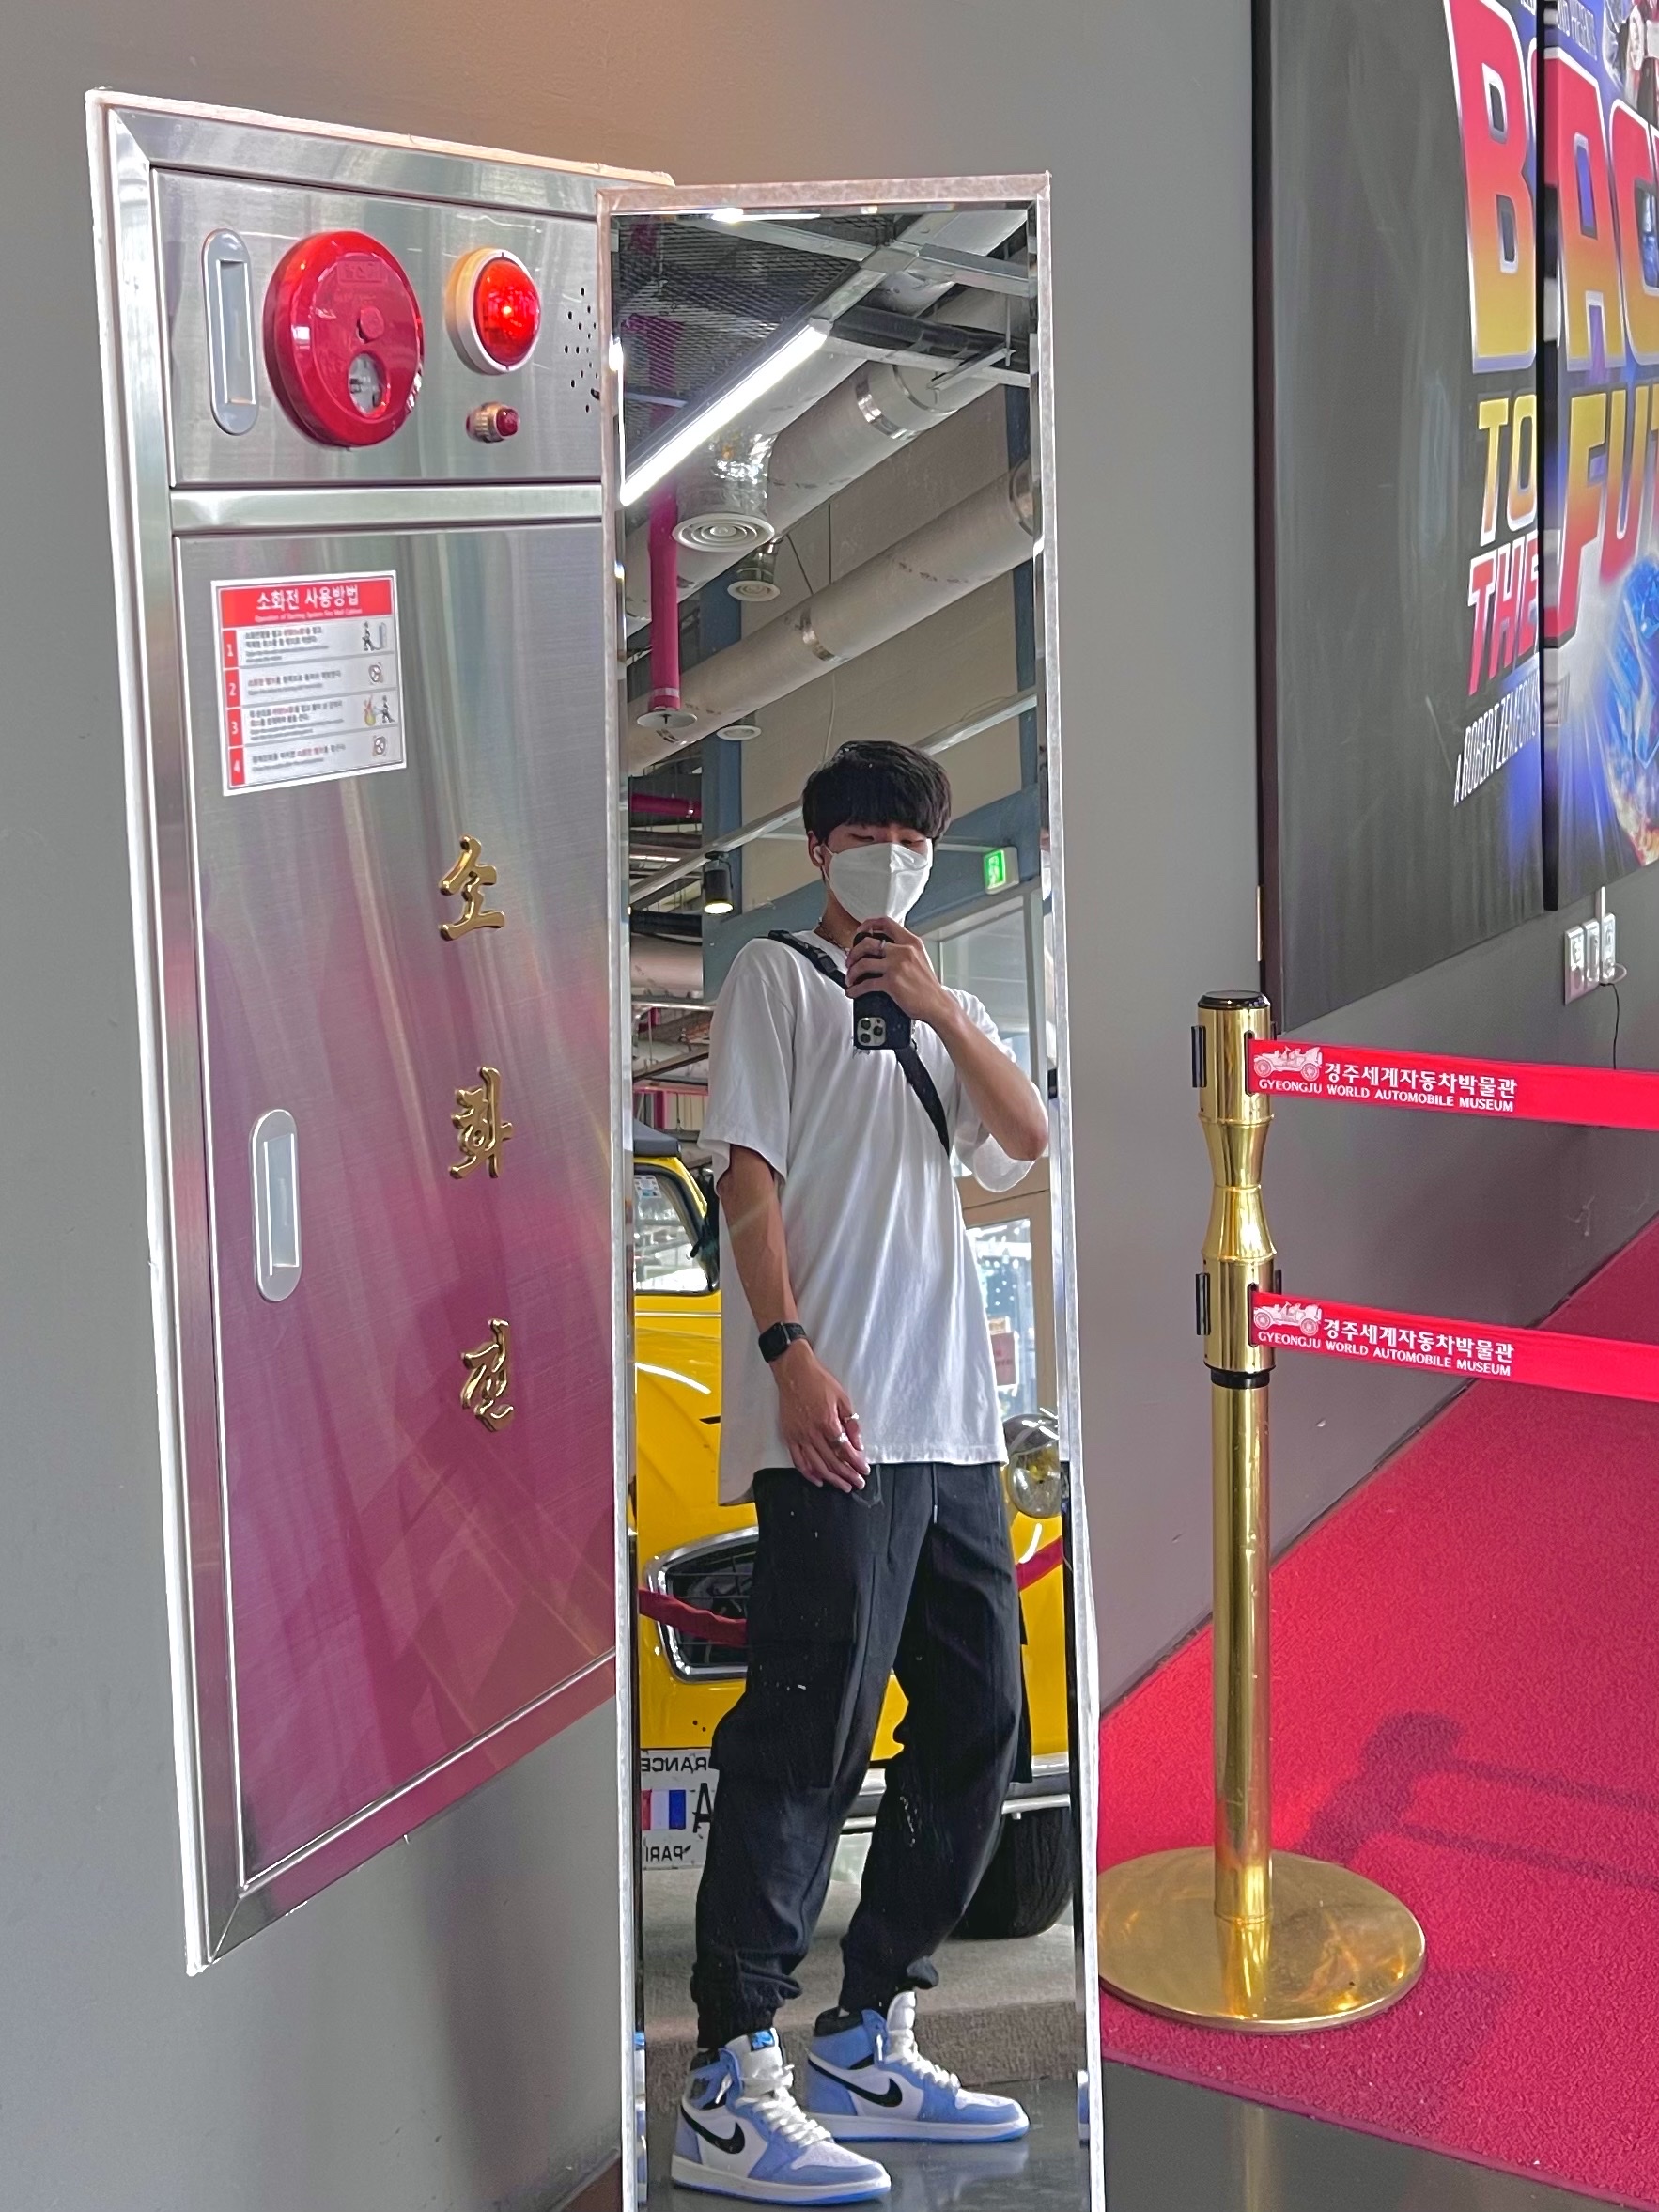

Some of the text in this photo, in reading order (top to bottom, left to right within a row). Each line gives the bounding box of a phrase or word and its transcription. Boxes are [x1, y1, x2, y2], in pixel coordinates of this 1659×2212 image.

[1444, 0, 1659, 373] BAC
[1479, 394, 1537, 547] TO
[256, 584, 359, 611] 소화전 사용방법
[1467, 529, 1539, 696] THE
[226, 644, 234, 657] 1
[228, 683, 236, 696] 2
[231, 721, 239, 735] 3
[233, 760, 240, 773] 4
[1461, 703, 1500, 801] ROBERT
[1258, 1078, 1514, 1113] GYEONGJU WORLD AUTOMOBILE MUSEUM
[1324, 1062, 1518, 1099] 경주세계자동차박물관
[1257, 1331, 1512, 1378] GYEONGJU WORLD AUTOMOBILE MUSEUM
[1322, 1317, 1515, 1363] 경주세계자동차박물관
